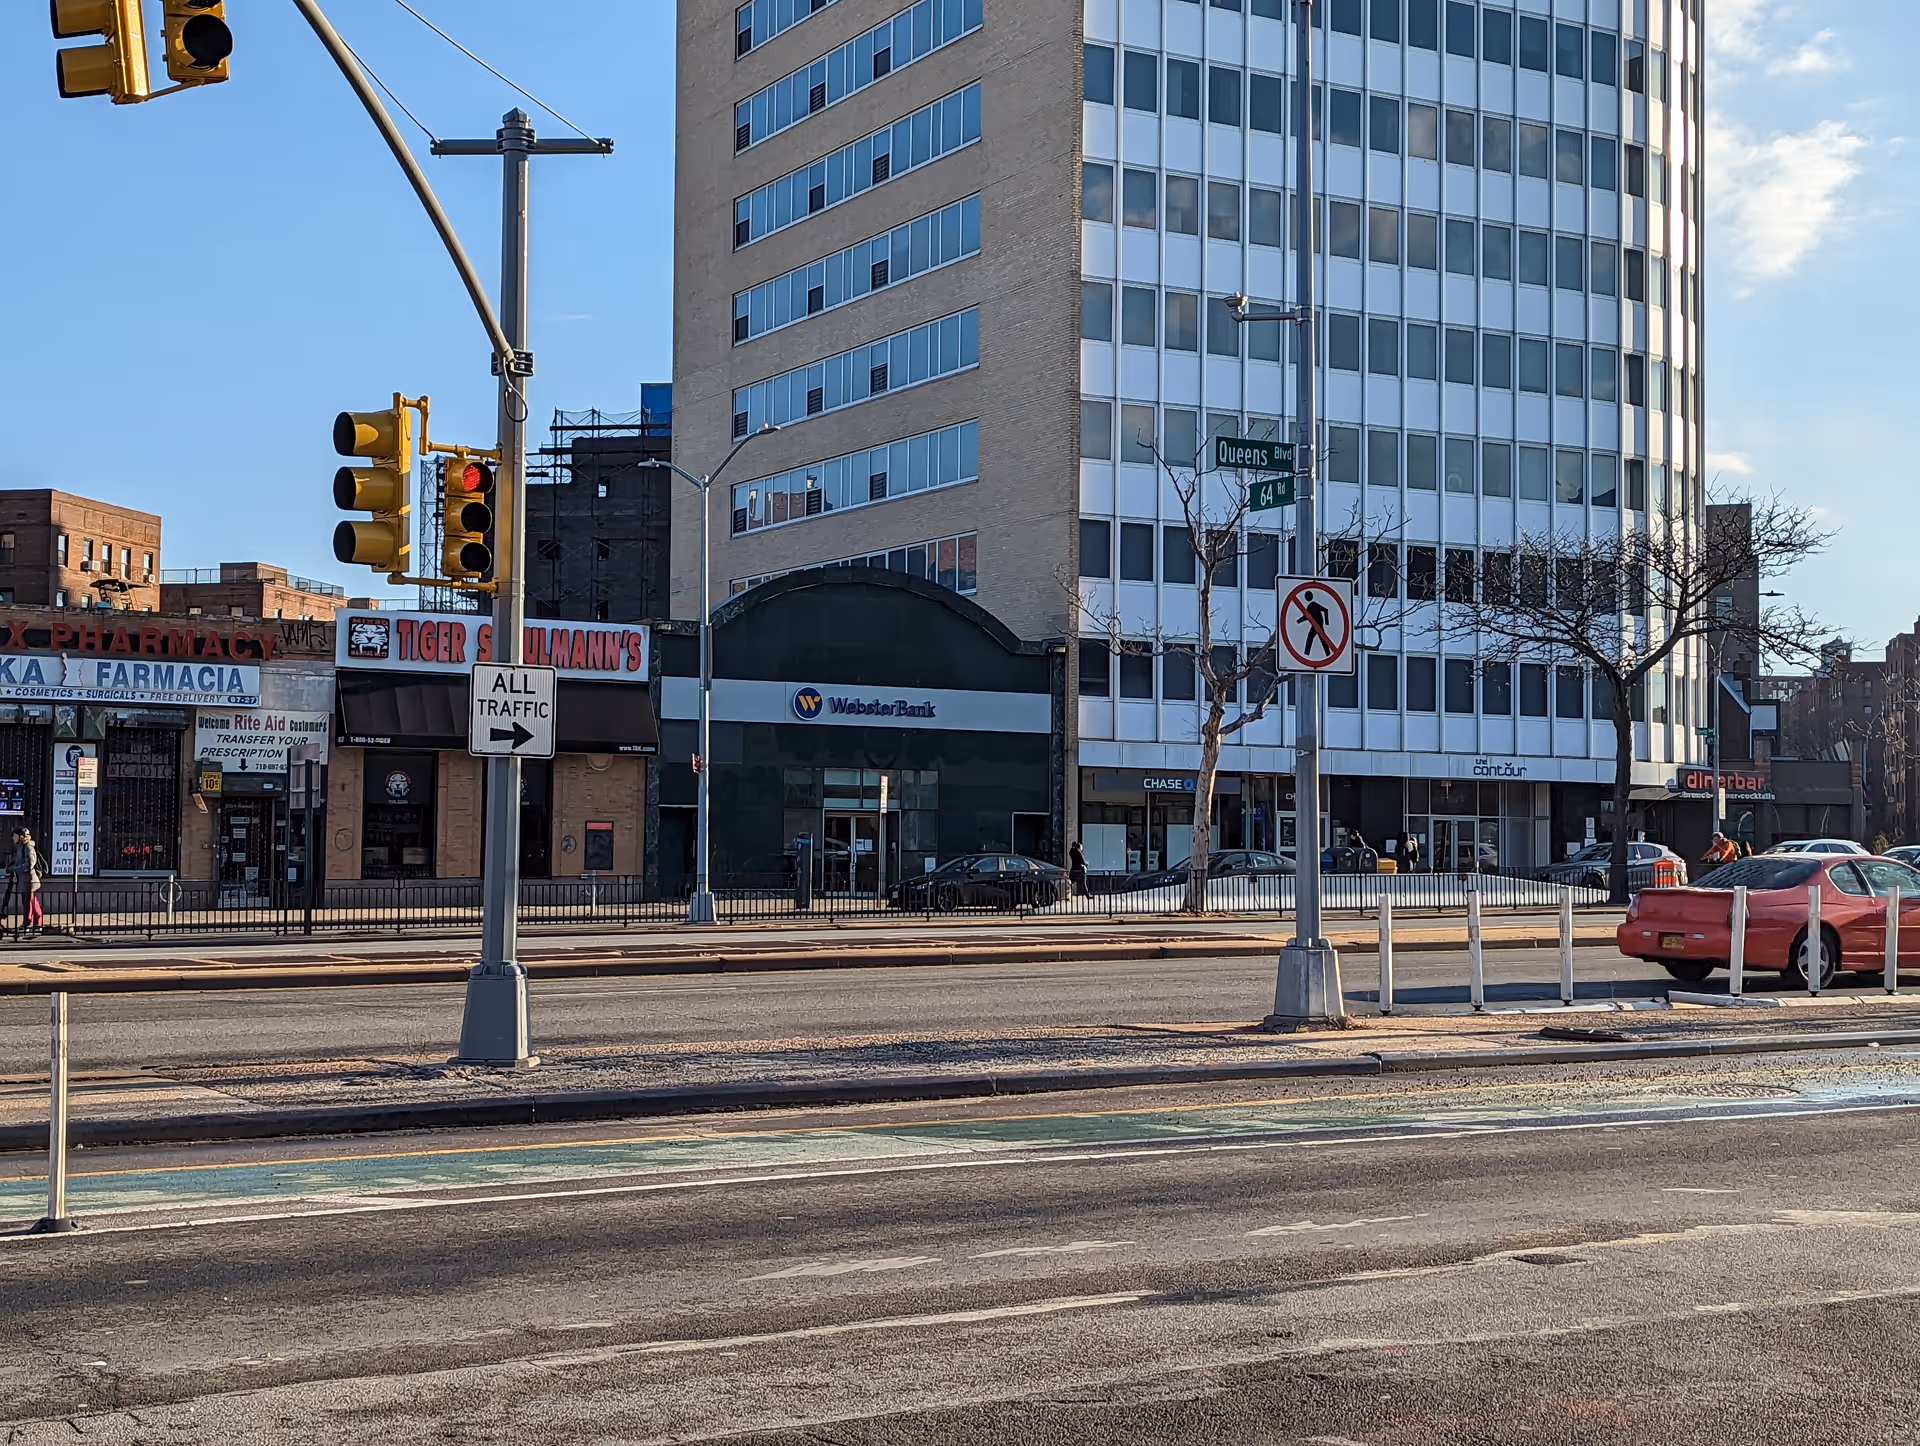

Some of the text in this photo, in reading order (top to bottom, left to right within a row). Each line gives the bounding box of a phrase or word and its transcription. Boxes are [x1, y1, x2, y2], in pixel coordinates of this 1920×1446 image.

[1219, 440, 1292, 466] Queens Blvd
[1260, 482, 1286, 507] 64 Rd
[50, 622, 279, 661] PHARMACY
[397, 618, 642, 672] TIGER SULMANN'S
[96, 661, 245, 694] FARMACIA
[491, 672, 536, 695] ALL
[15, 687, 74, 698] COSMETICS
[86, 689, 137, 700] SURGICALS
[150, 692, 174, 702] FREE
[176, 693, 222, 703] DELIVERY
[476, 698, 549, 719] TRAFFIC
[198, 713, 328, 733] Welcome Rite Aid Customers
[216, 734, 309, 746] TRANSFER YOUR
[200, 747, 284, 759] PRESCRIPTION
[1143, 778, 1183, 789] CHASE
[56, 841, 90, 852] LOTTO
